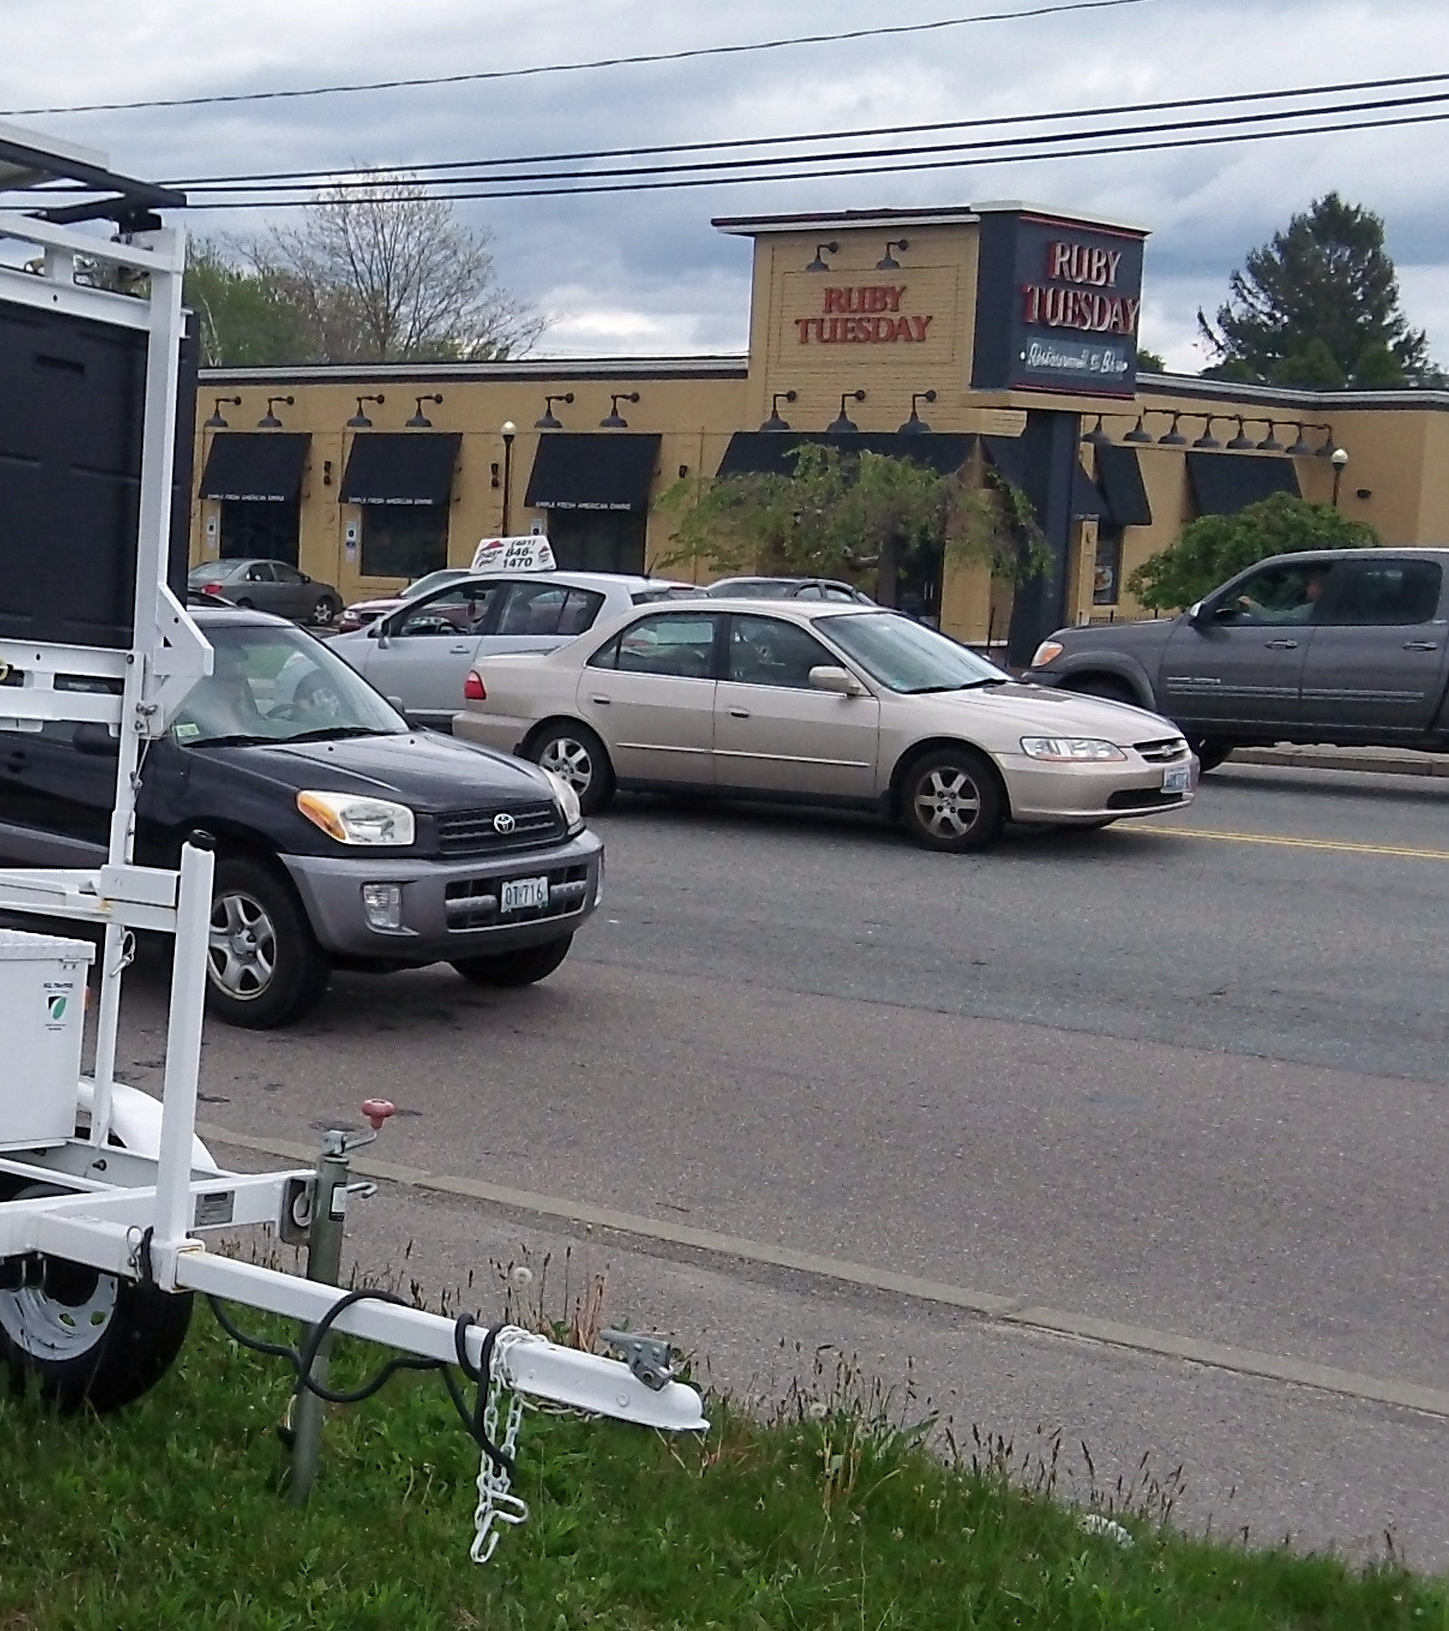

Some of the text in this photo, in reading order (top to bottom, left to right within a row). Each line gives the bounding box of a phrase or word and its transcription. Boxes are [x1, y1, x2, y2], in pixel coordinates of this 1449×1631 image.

[1049, 240, 1122, 288] RUBY
[823, 284, 907, 313] RUBY
[1022, 283, 1141, 335] TUESDAY
[795, 315, 933, 344] TUESDAY
[502, 557, 533, 568] 1470
